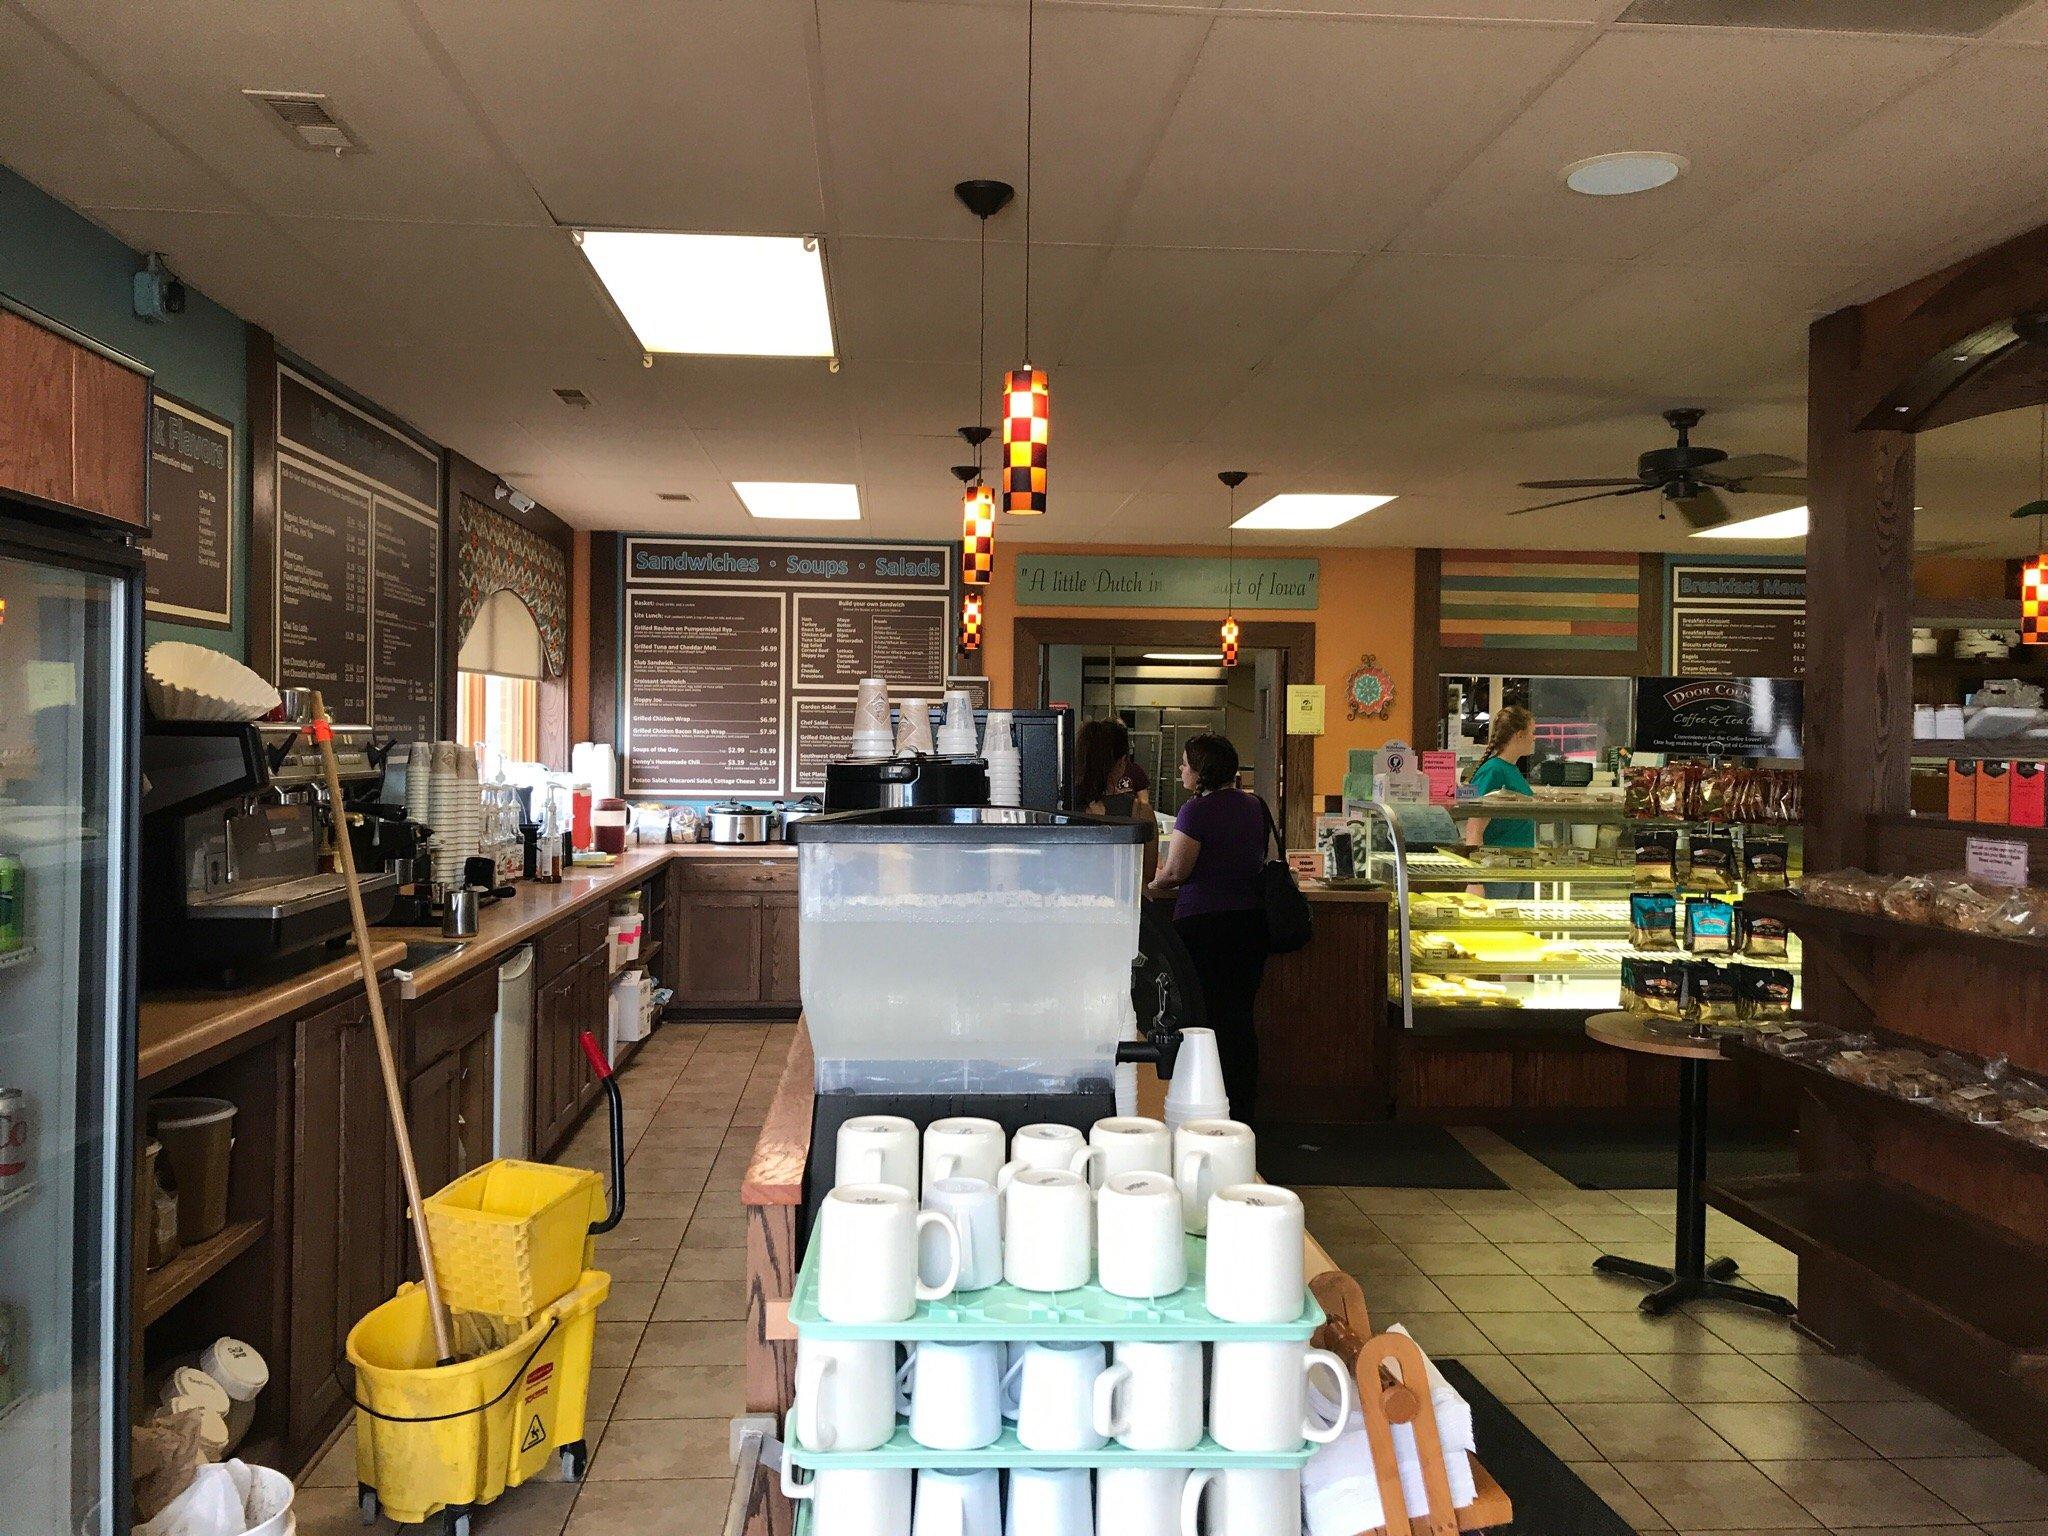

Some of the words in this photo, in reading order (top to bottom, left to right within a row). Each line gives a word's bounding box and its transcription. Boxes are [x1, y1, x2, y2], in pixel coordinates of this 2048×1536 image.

[636, 551, 760, 573] Sandwiches
[786, 556, 849, 578] Soups
[876, 557, 941, 577] Salads
[1052, 570, 1087, 592] little
[1091, 568, 1143, 592] Dutch
[1248, 574, 1265, 602] of
[1681, 578, 1759, 594] Breakfast
[1673, 713, 1707, 727] Coffee
[1723, 714, 1744, 724] Tea
